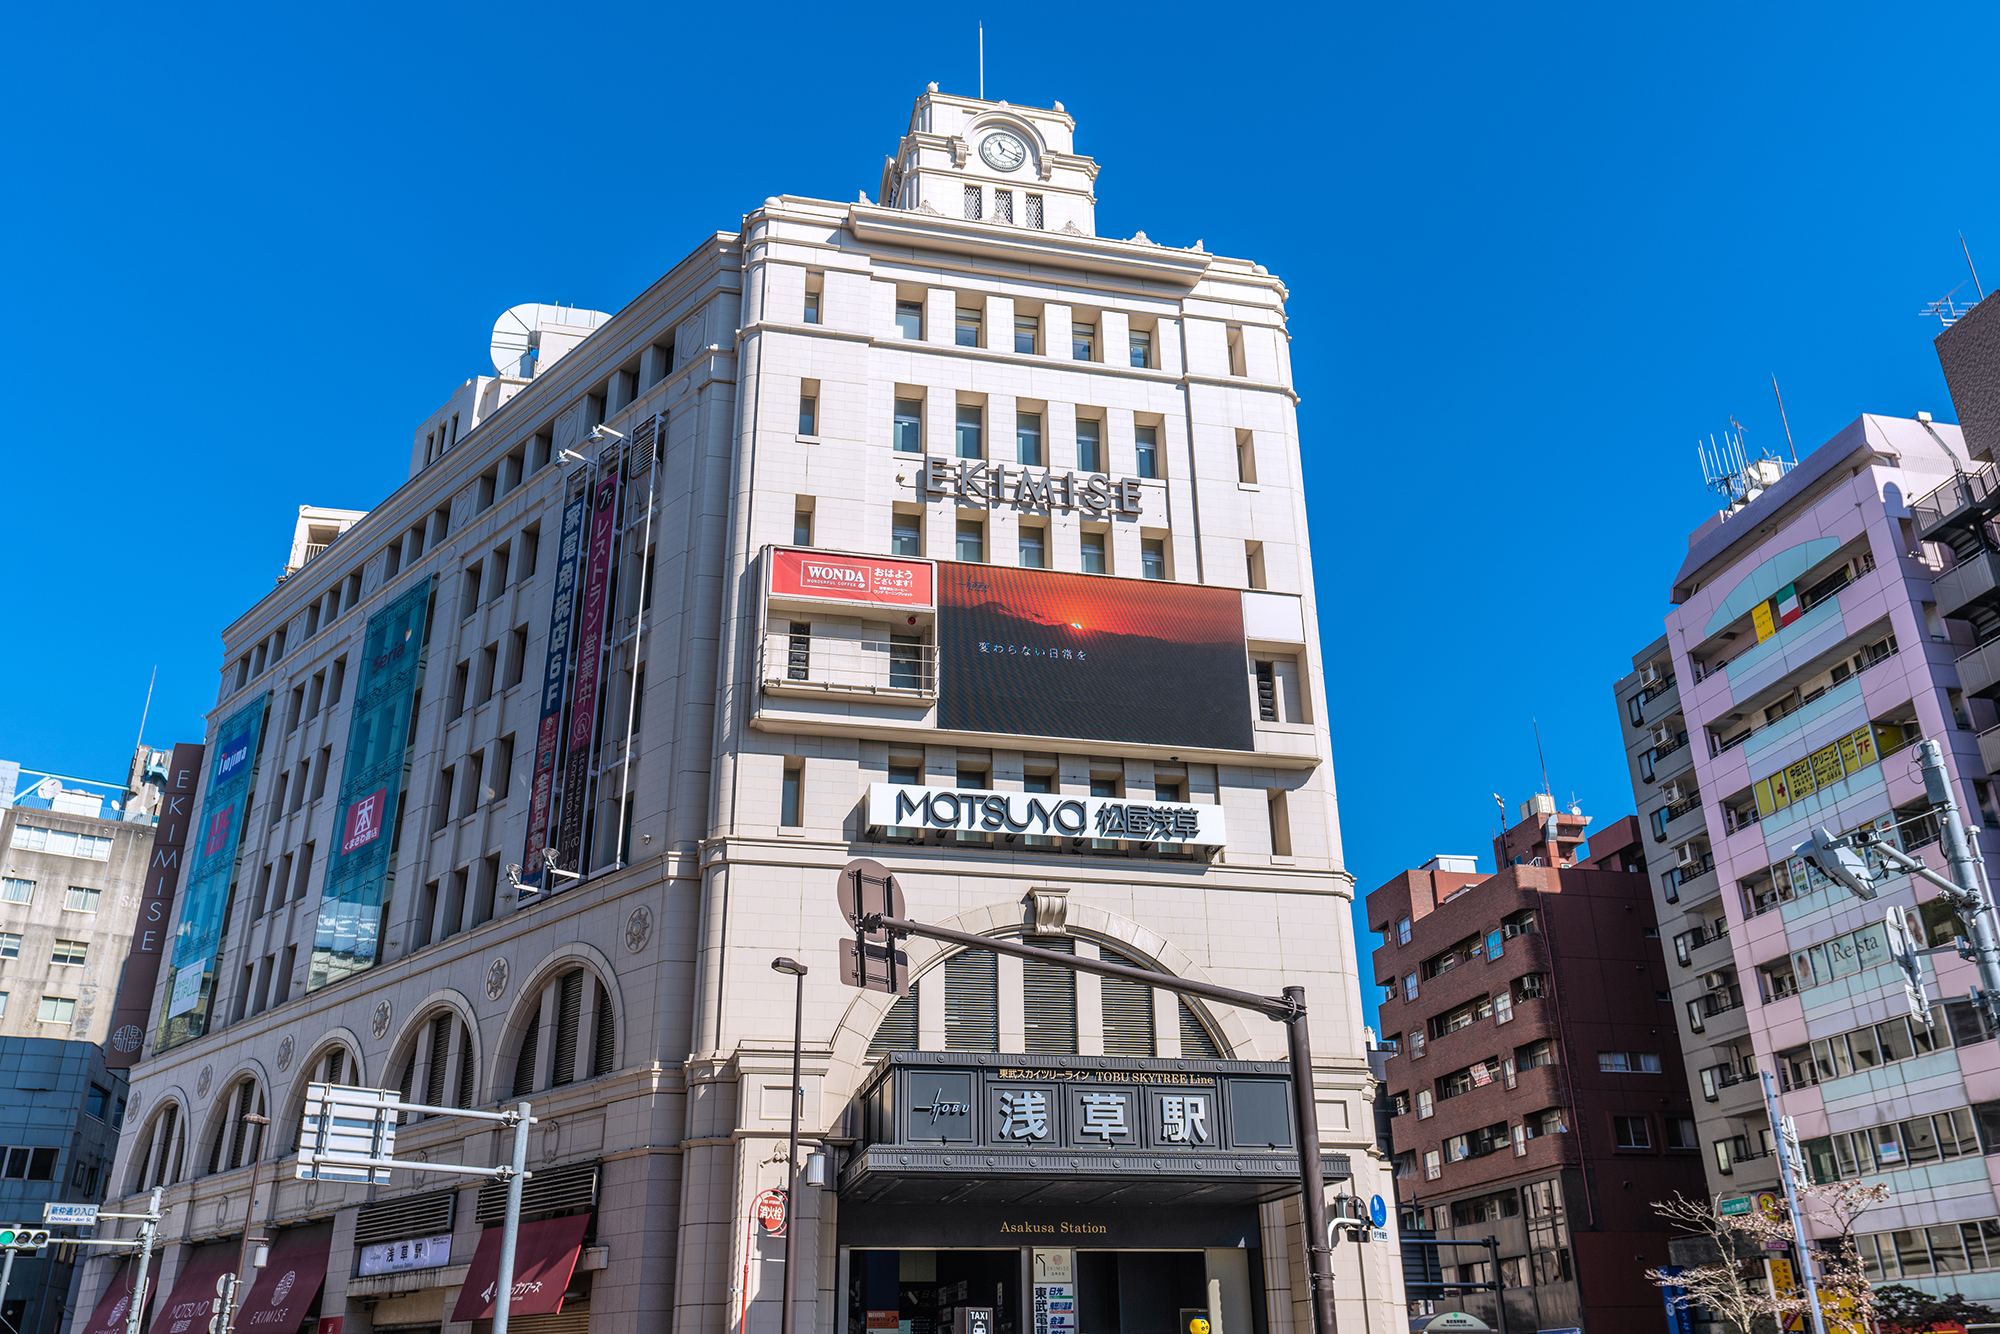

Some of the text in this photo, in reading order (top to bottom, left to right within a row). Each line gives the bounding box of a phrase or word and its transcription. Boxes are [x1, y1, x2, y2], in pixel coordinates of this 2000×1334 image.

[926, 457, 1143, 514] EKIMISE
[600, 491, 613, 509] 7F
[807, 565, 865, 583] WONDA
[874, 567, 913, 580] おはよう
[578, 519, 610, 707] レストラン営業中
[372, 641, 405, 674] Seria
[978, 641, 1087, 661] 変わらない日常を
[1856, 738, 1871, 756] 7F
[207, 804, 234, 840] ABC
[1095, 802, 1200, 841] 松屋浅草
[203, 831, 229, 859] MART
[141, 769, 191, 951] EKIMISE
[1799, 883, 1808, 892] TEL
[999, 1068, 1214, 1086] 東武スカイツリーライン TOBU SKYTREE Line
[999, 1091, 1209, 1143] 浅草駅
[51, 1206, 96, 1216] 新仲通り入口
[759, 1205, 783, 1221] 消火栓
[1000, 1221, 1108, 1234] Asakusa Station
[1049, 1287, 1064, 1295] 日光
[250, 1308, 289, 1325] EKIMISE
[970, 1311, 988, 1320] TAXI
[1050, 1316, 1065, 1325] 会津
